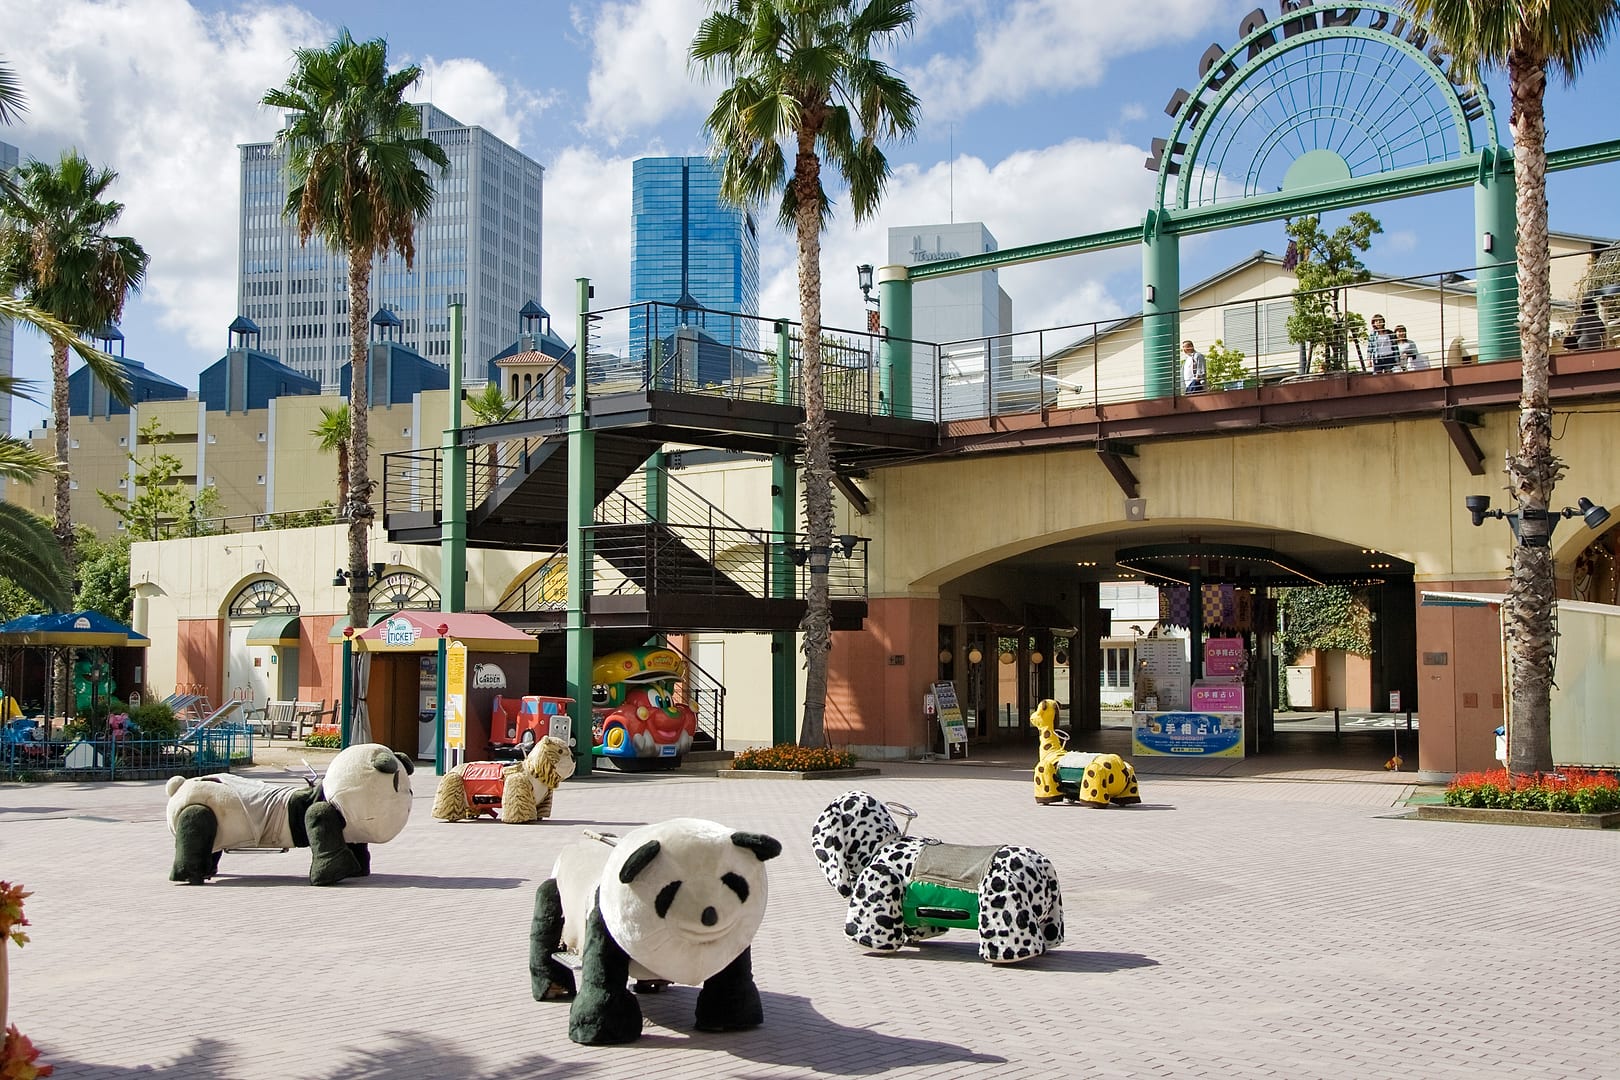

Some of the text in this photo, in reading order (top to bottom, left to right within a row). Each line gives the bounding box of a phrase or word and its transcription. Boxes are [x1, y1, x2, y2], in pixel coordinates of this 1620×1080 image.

[385, 573, 417, 587] TOILET
[390, 632, 413, 642] TICKET
[1215, 649, 1242, 657] 手相占い
[479, 675, 501, 684] GARDEN
[1203, 691, 1235, 699] 手相占い
[1165, 723, 1224, 735] 手相占い
